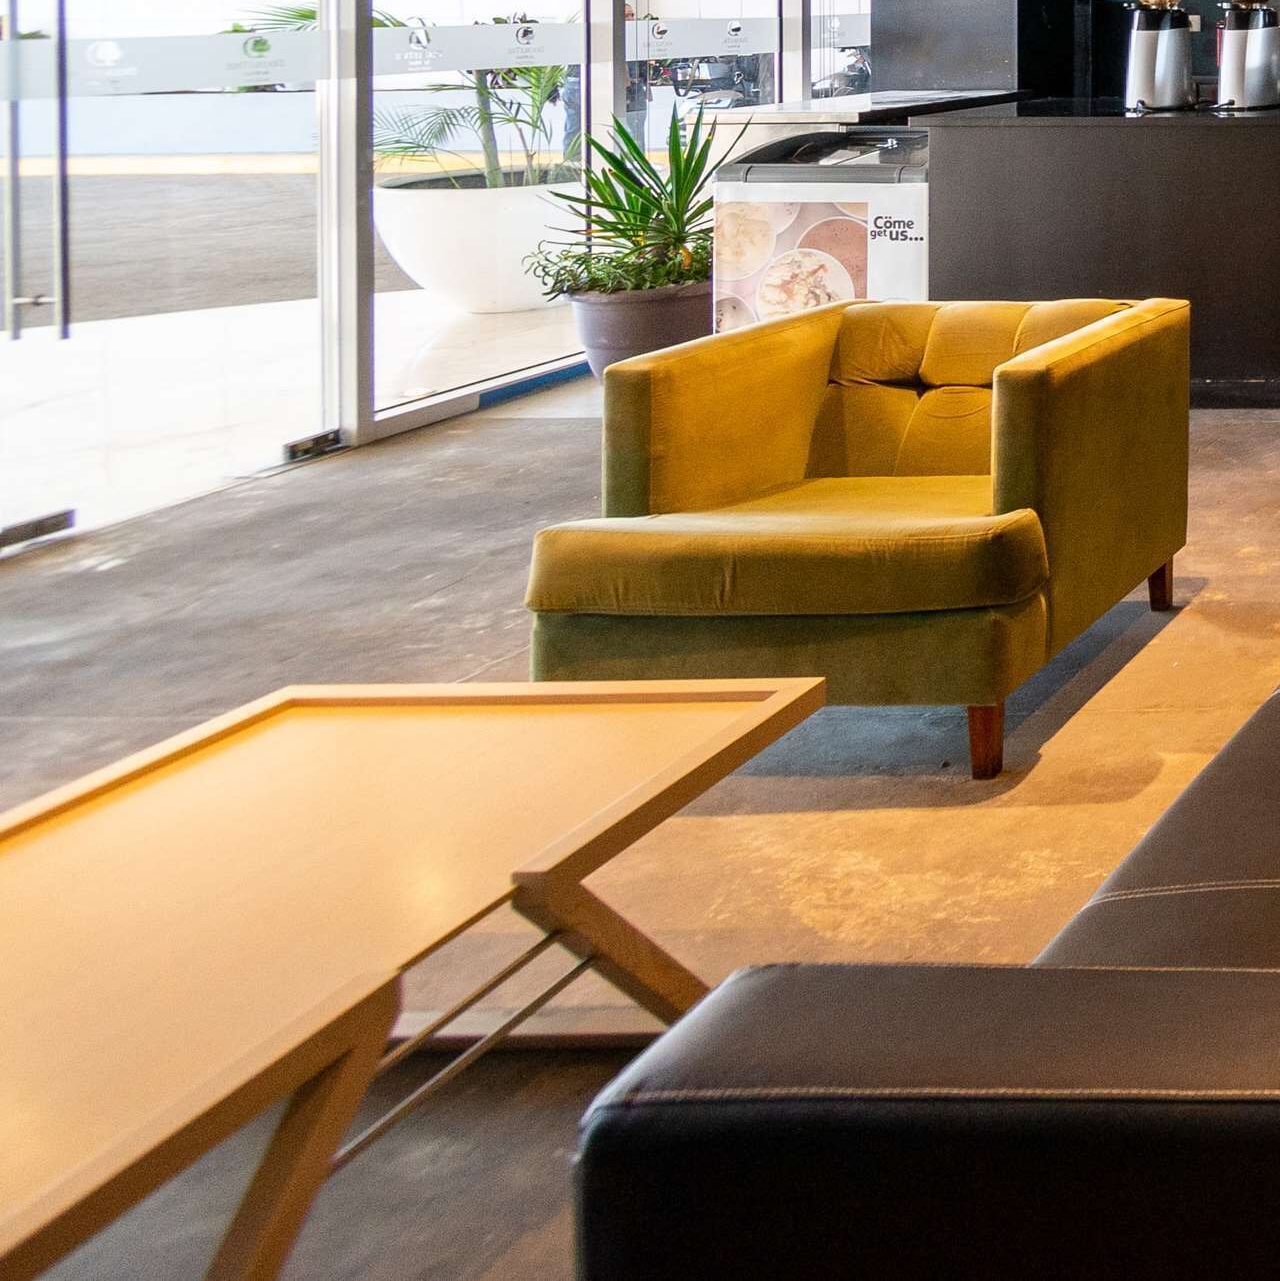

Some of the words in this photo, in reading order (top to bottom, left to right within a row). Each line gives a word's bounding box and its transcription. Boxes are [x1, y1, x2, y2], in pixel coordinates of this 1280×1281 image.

[874, 216, 915, 229] Cöme
[870, 229, 888, 240] get
[889, 230, 924, 241] us...
